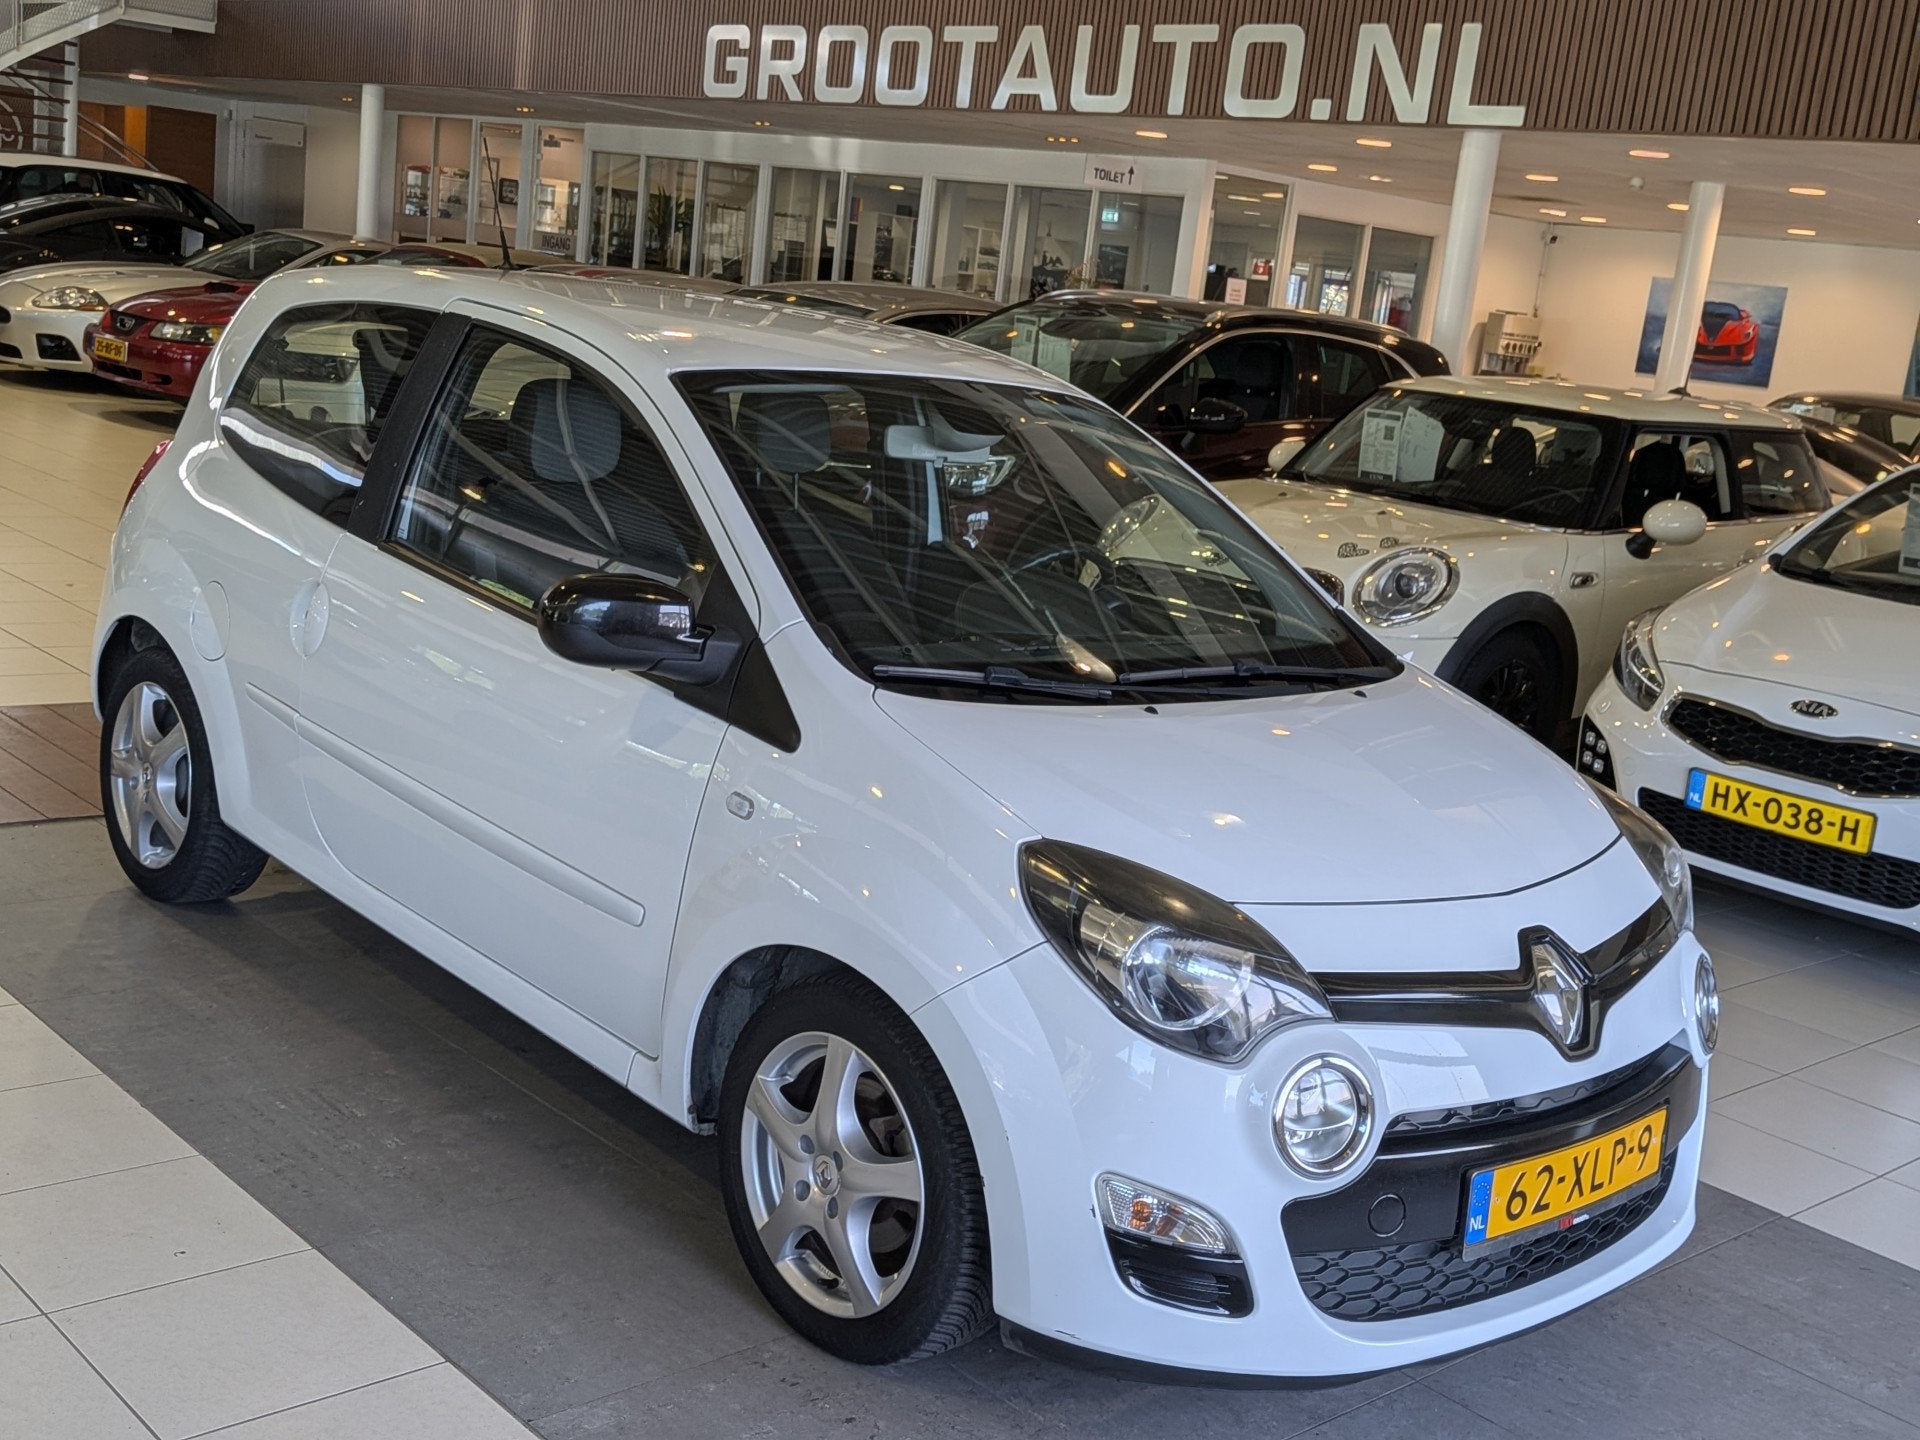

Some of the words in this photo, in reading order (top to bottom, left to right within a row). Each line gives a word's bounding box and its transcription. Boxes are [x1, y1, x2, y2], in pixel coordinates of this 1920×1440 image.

[703, 22, 1526, 127] GROOTAUTO.NL
[1094, 167, 1125, 184] TOILET
[541, 234, 571, 251] INGANG
[1796, 701, 1829, 716] KIA
[1689, 791, 1701, 803] NL
[1710, 781, 1861, 846] HX-038-H
[1505, 1124, 1653, 1221] 62-XLP-9
[1469, 1216, 1485, 1232] NL
